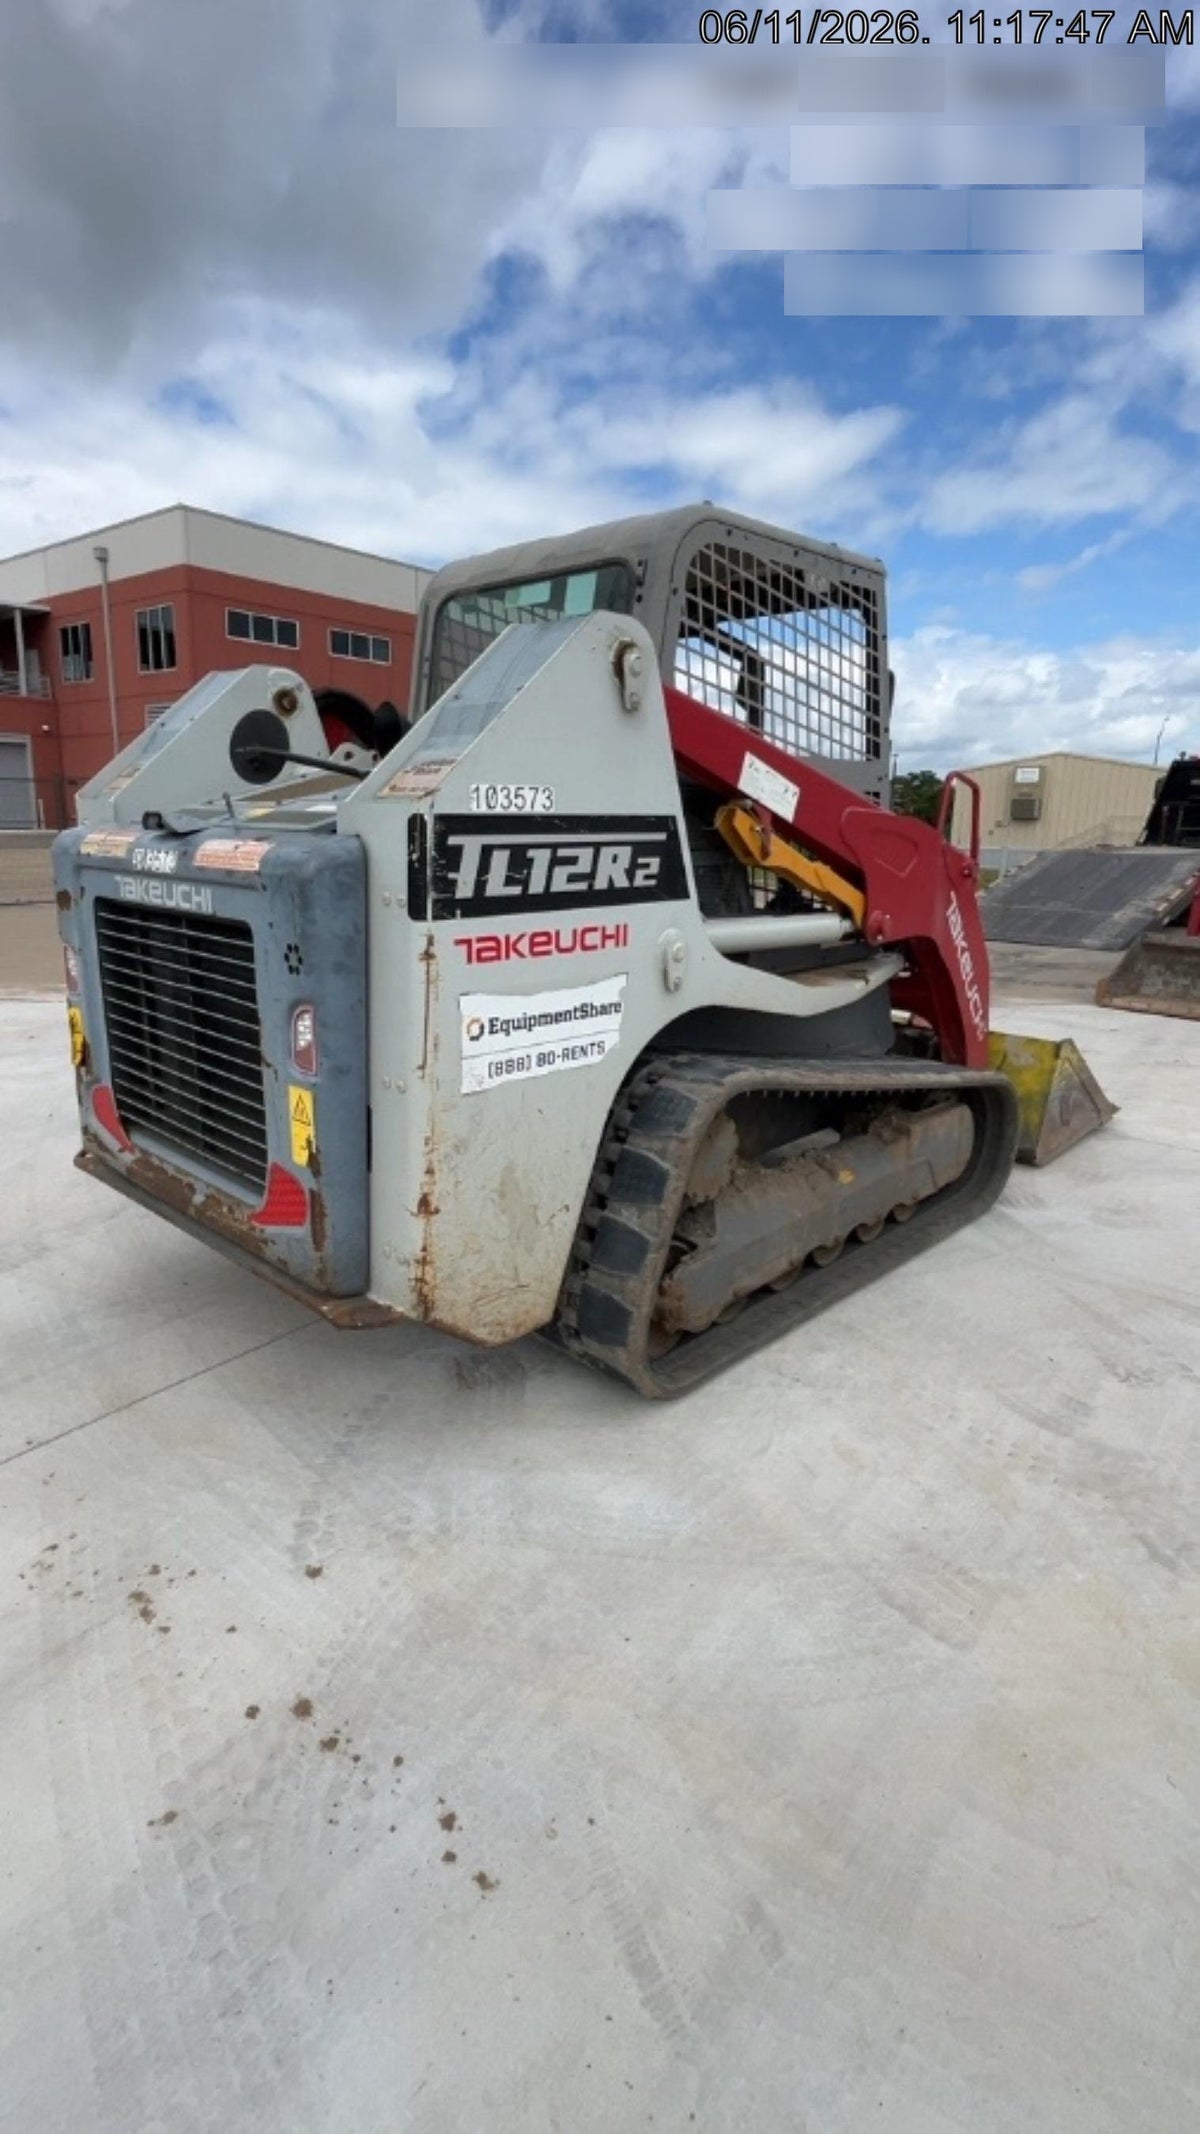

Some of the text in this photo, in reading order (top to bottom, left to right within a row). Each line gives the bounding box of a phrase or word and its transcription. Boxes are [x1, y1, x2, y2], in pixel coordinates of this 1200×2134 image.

[471, 785, 554, 812] 103573
[488, 1001, 622, 1037] EquipmentShare
[536, 1041, 606, 1068] 80-RENTS
